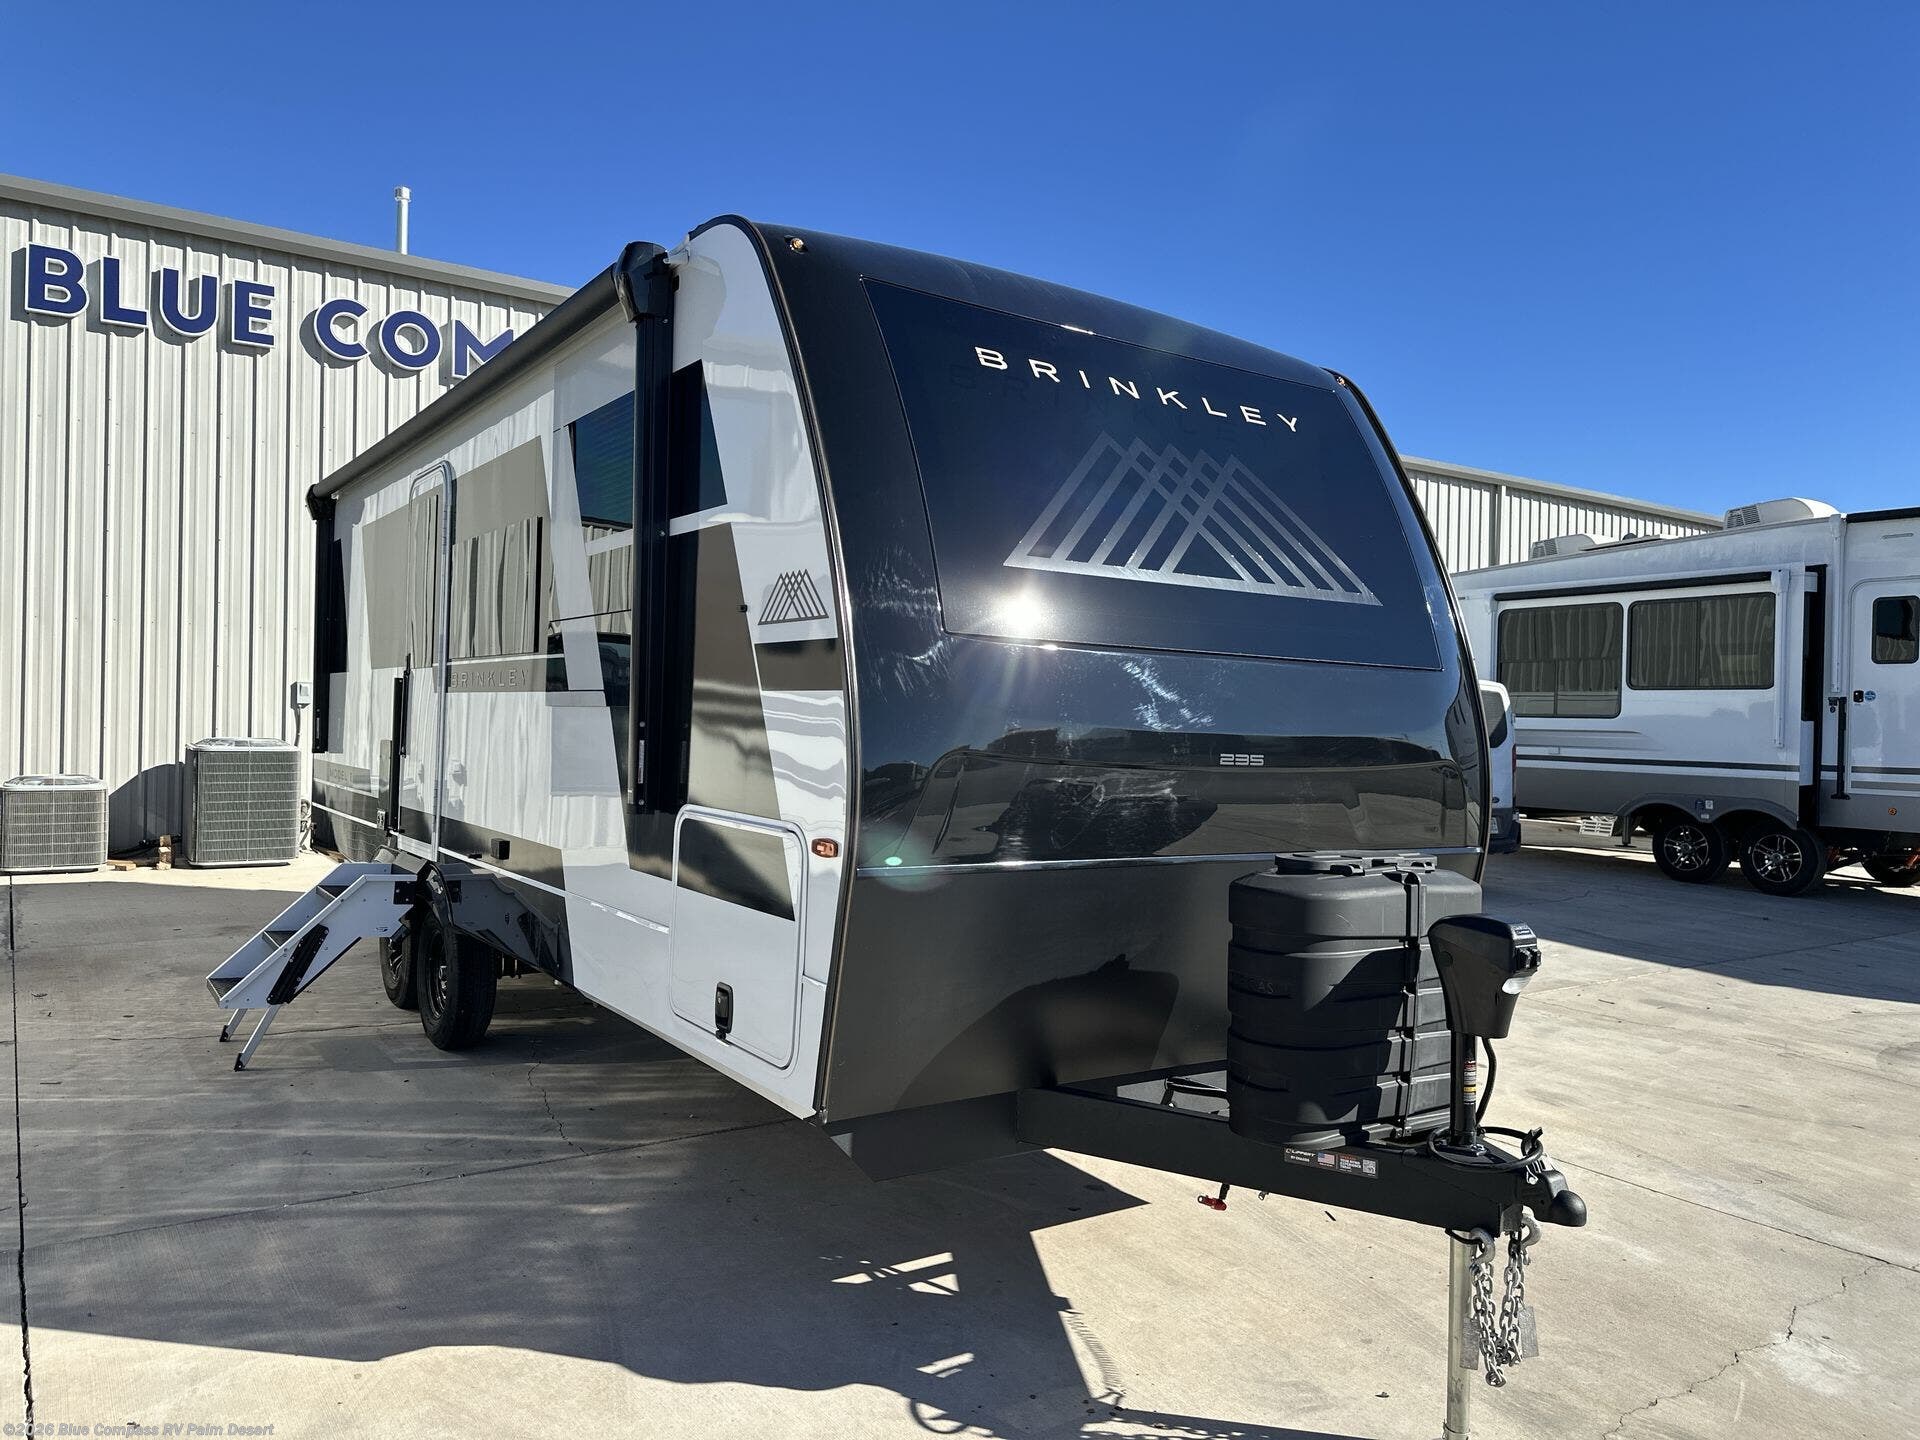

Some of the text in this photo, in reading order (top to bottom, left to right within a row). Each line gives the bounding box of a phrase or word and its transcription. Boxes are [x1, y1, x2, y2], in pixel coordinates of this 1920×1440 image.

[25, 242, 275, 348] BLUE
[974, 346, 1298, 433] BRINKLEY
[450, 669, 529, 688] BRINKLEY
[1219, 753, 1264, 766] 235
